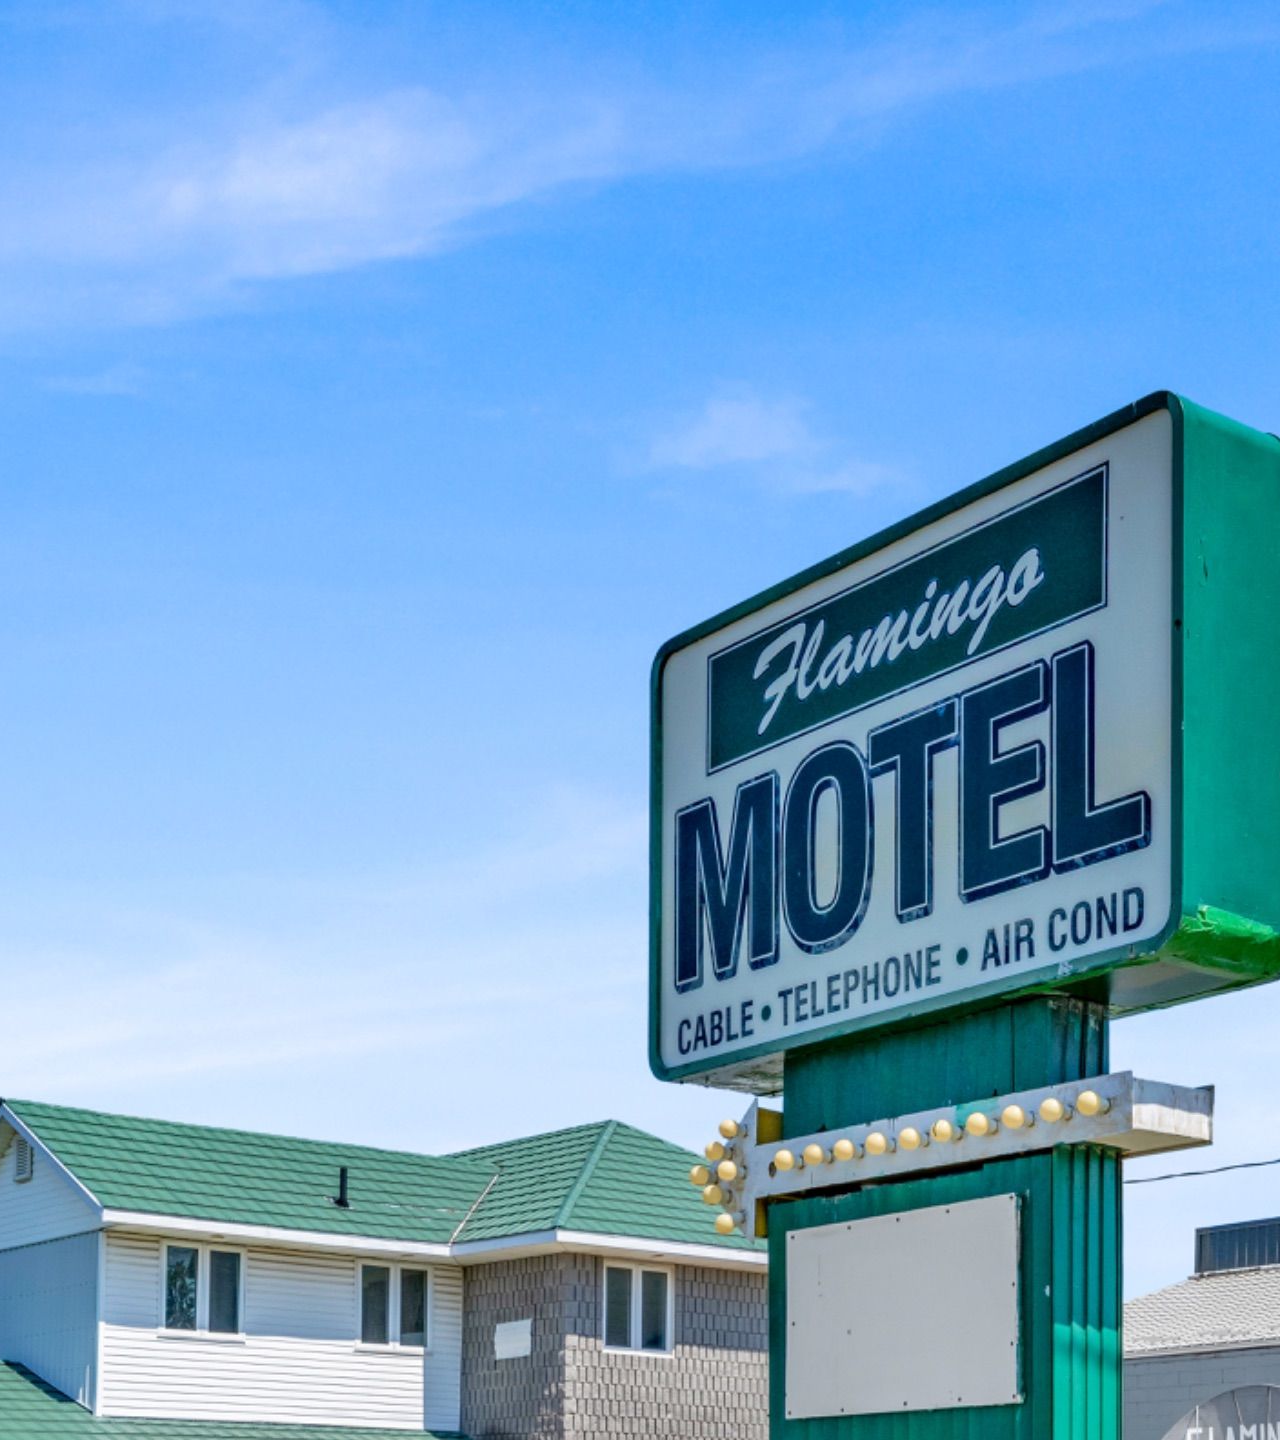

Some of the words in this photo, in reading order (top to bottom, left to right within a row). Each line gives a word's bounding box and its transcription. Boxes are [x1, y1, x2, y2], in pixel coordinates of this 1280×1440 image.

[753, 547, 1045, 736] Flamingo
[674, 639, 1152, 994] MOTEL
[677, 1000, 754, 1055] CABLE
[777, 944, 941, 1027] TELEPHONE
[980, 917, 1036, 971] AIR
[1048, 886, 1145, 952] COND
